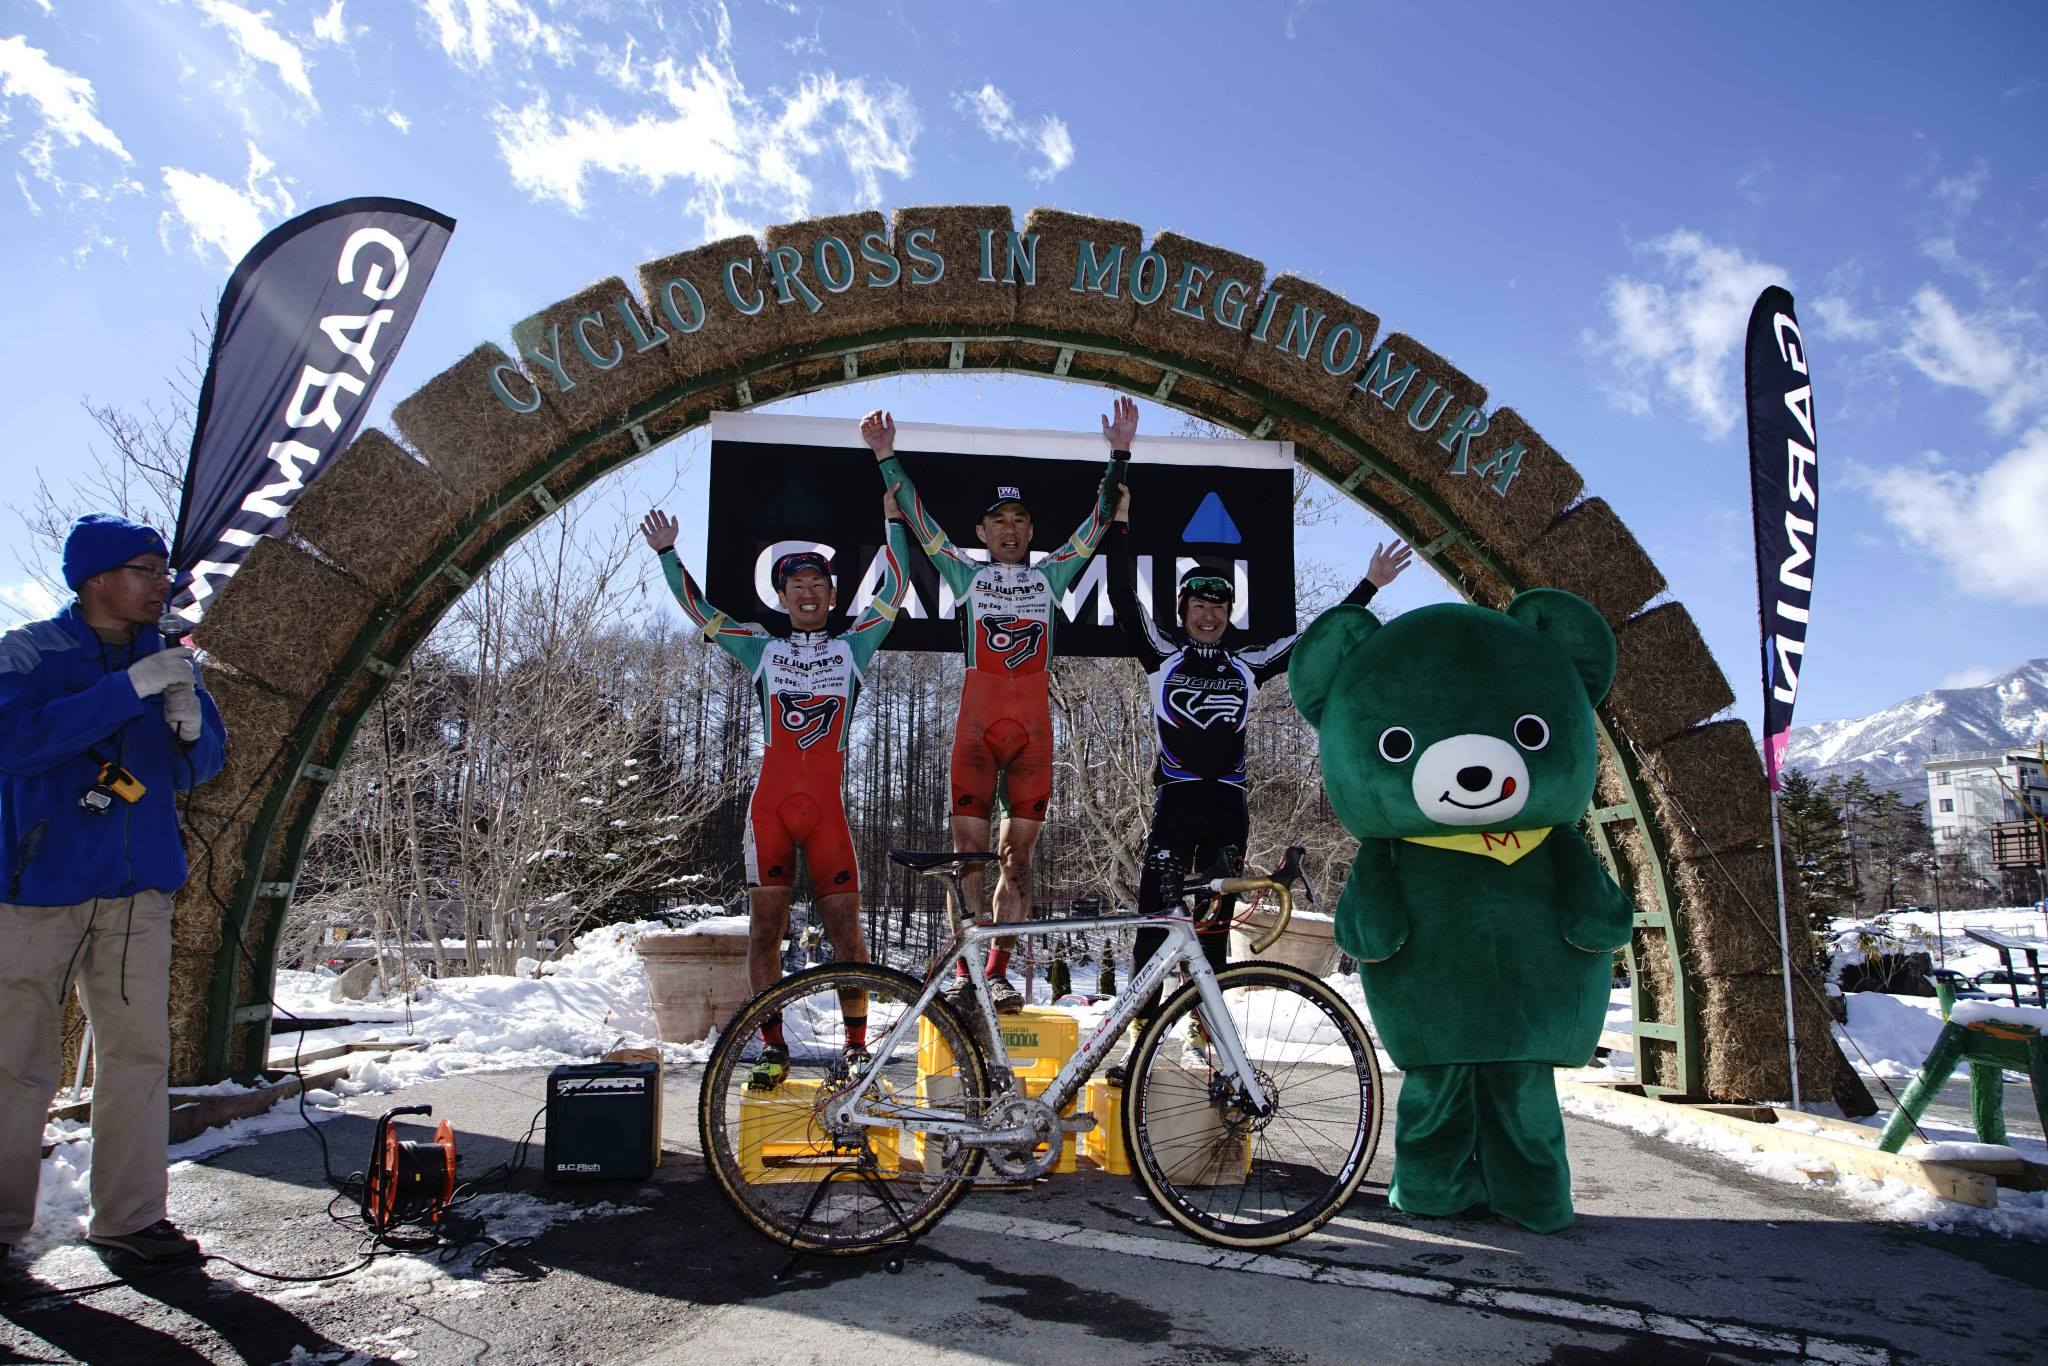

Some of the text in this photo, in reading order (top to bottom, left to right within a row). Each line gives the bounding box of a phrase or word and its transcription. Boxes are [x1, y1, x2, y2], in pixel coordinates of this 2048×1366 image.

[486, 277, 706, 414] CYCLO
[722, 227, 945, 314] CROSS
[976, 227, 1041, 287] IN
[1481, 831, 1521, 851] M
